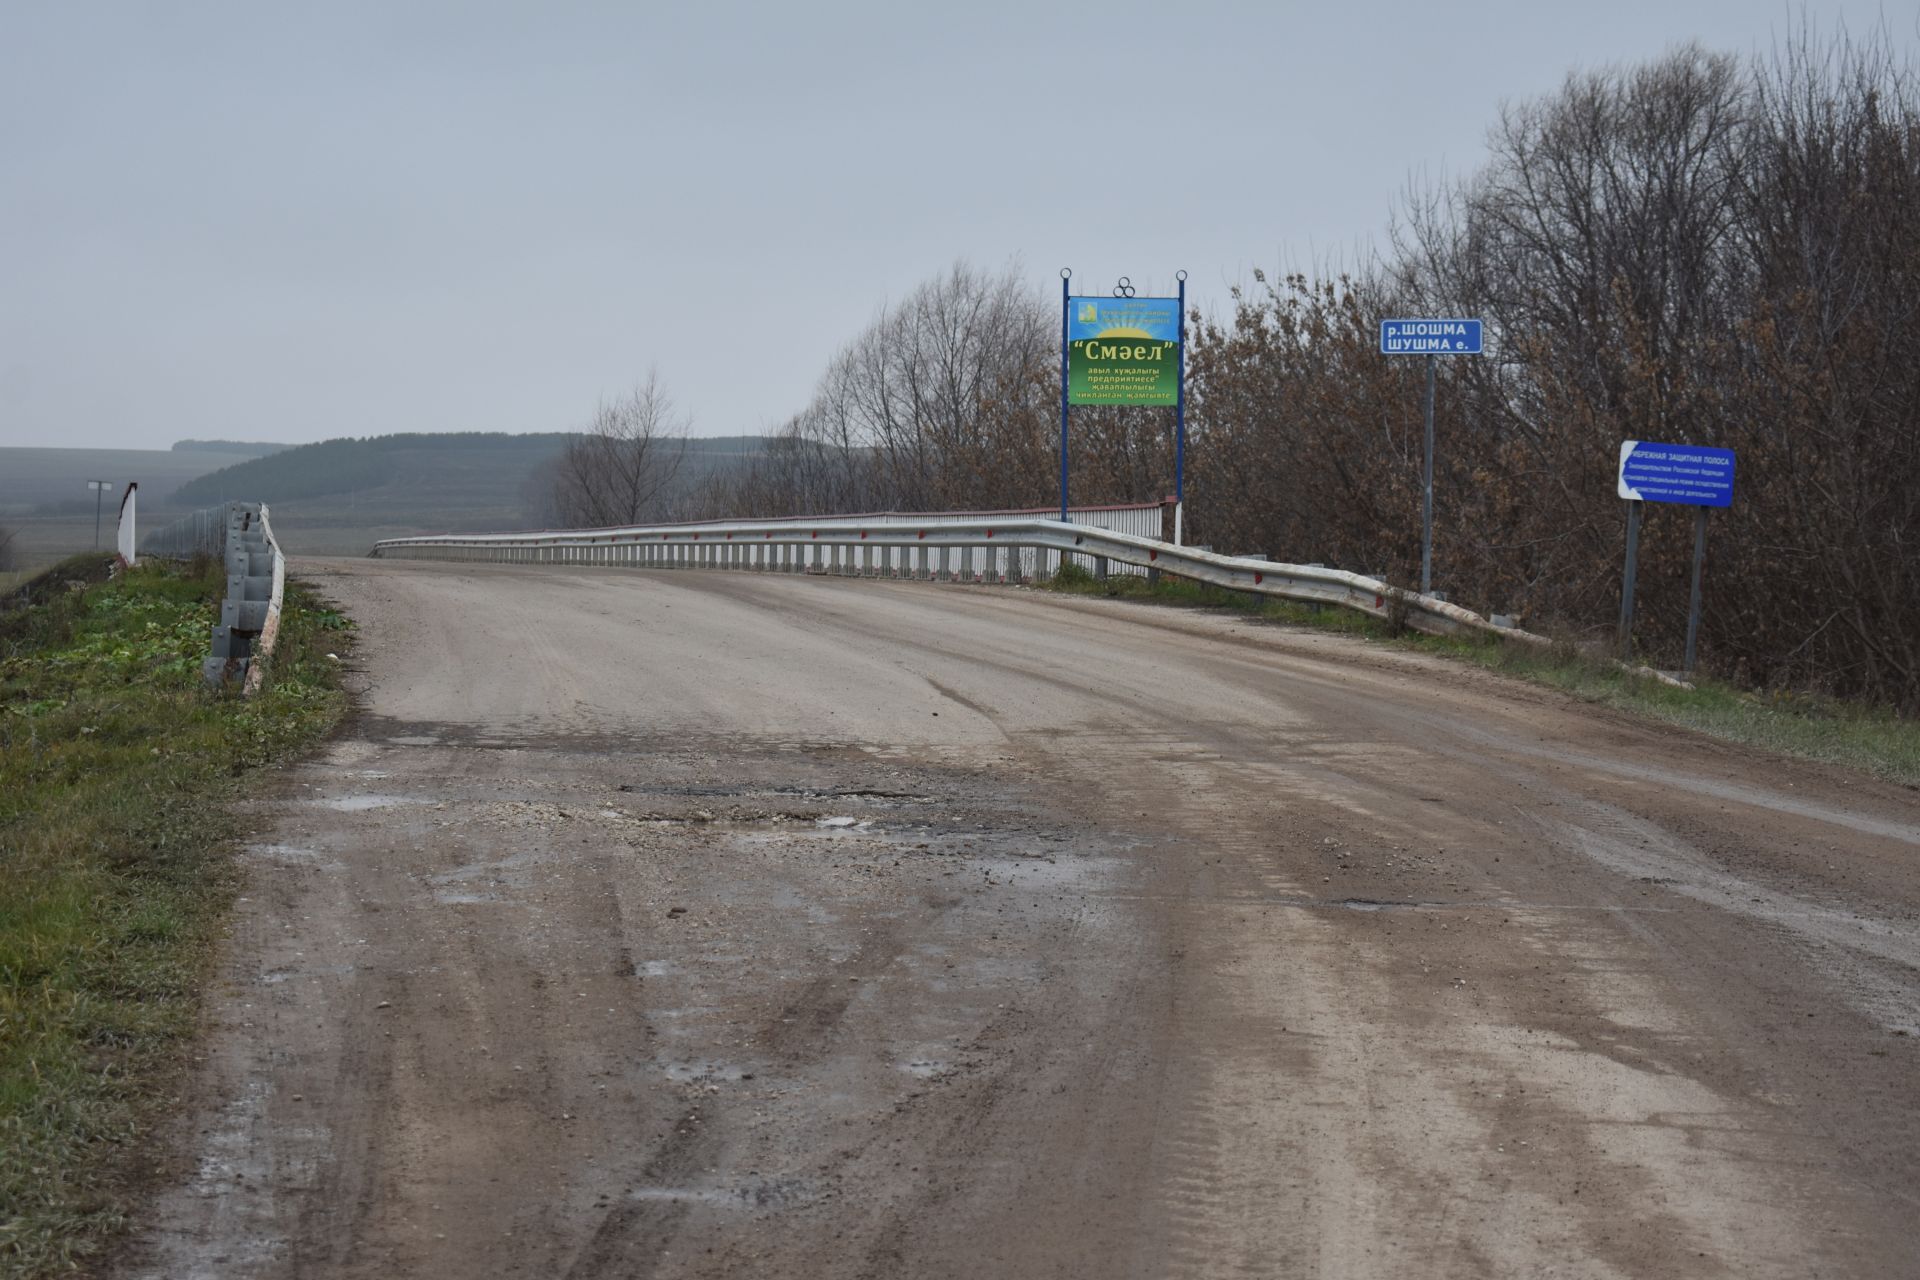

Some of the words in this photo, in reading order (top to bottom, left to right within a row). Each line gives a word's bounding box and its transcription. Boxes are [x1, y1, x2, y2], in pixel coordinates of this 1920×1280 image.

[1388, 339, 1451, 350] ШУШМА
[1456, 341, 1469, 350] е.
[1703, 456, 1730, 465] ПОЛОСА
